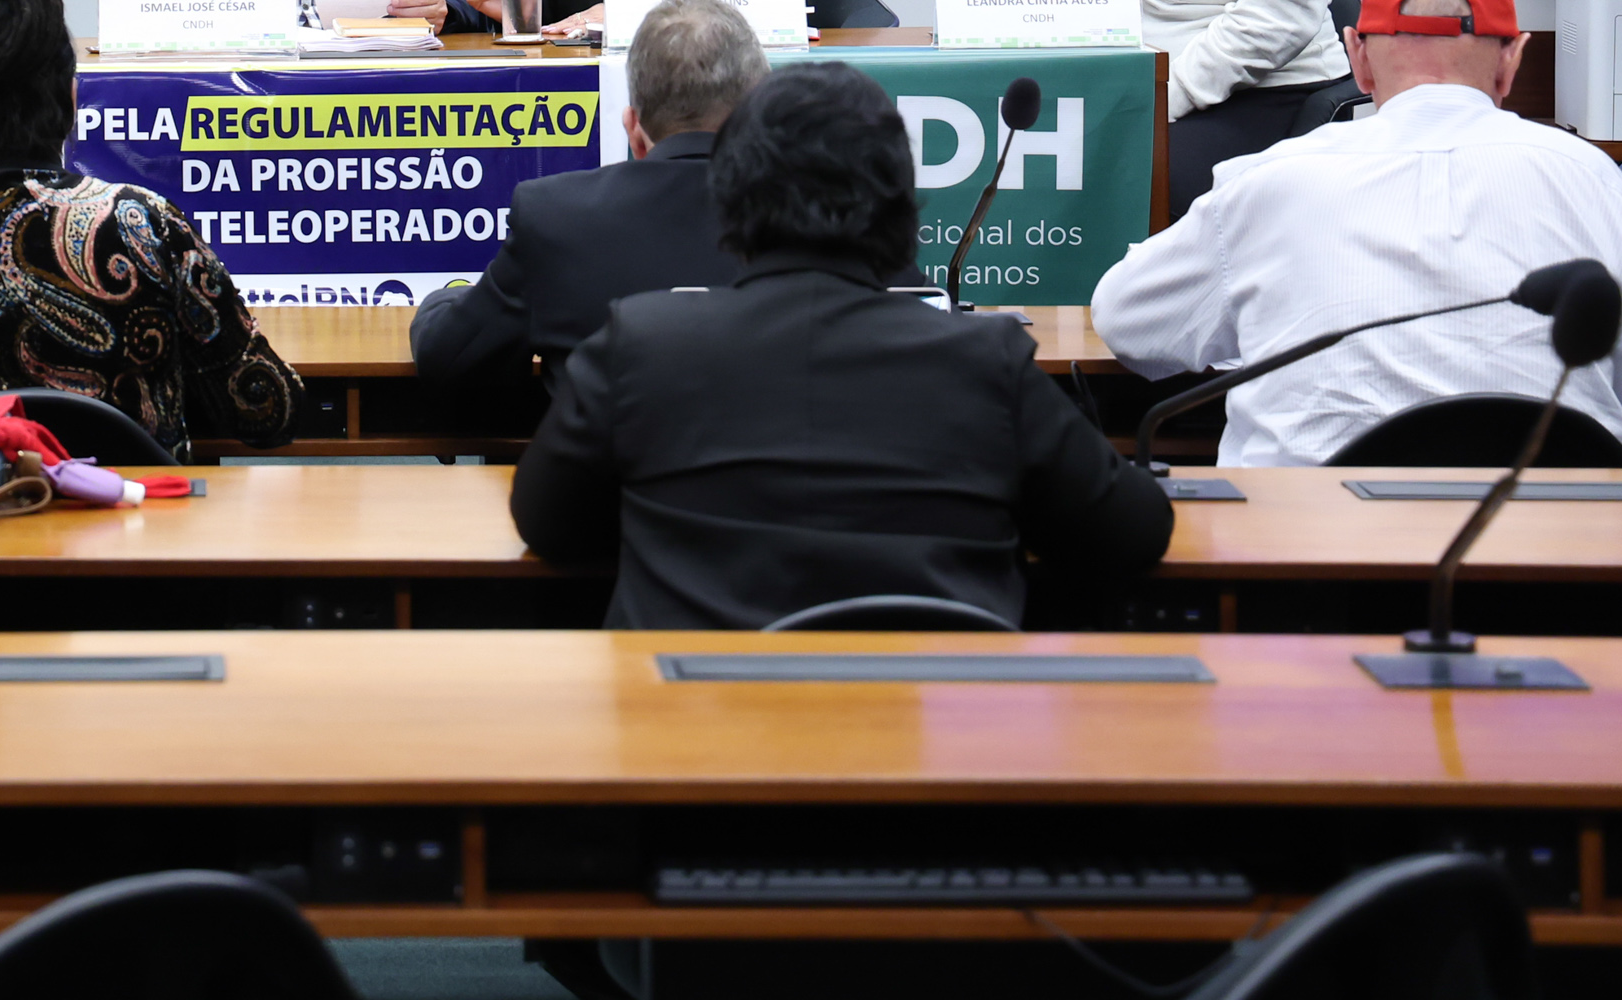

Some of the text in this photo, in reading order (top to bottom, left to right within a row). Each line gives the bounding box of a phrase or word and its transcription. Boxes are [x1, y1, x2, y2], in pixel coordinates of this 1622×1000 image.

[140, 0, 256, 13] ISMAEL JOSÉ CÉSAR
[1022, 14, 1055, 23] CNDH
[182, 20, 214, 30] CNDH
[77, 95, 587, 146] PELA REGULAMENTAÇÃO
[897, 95, 1084, 190] DH
[182, 148, 483, 193] DA PROFISSÃO
[1025, 219, 1083, 246] dos
